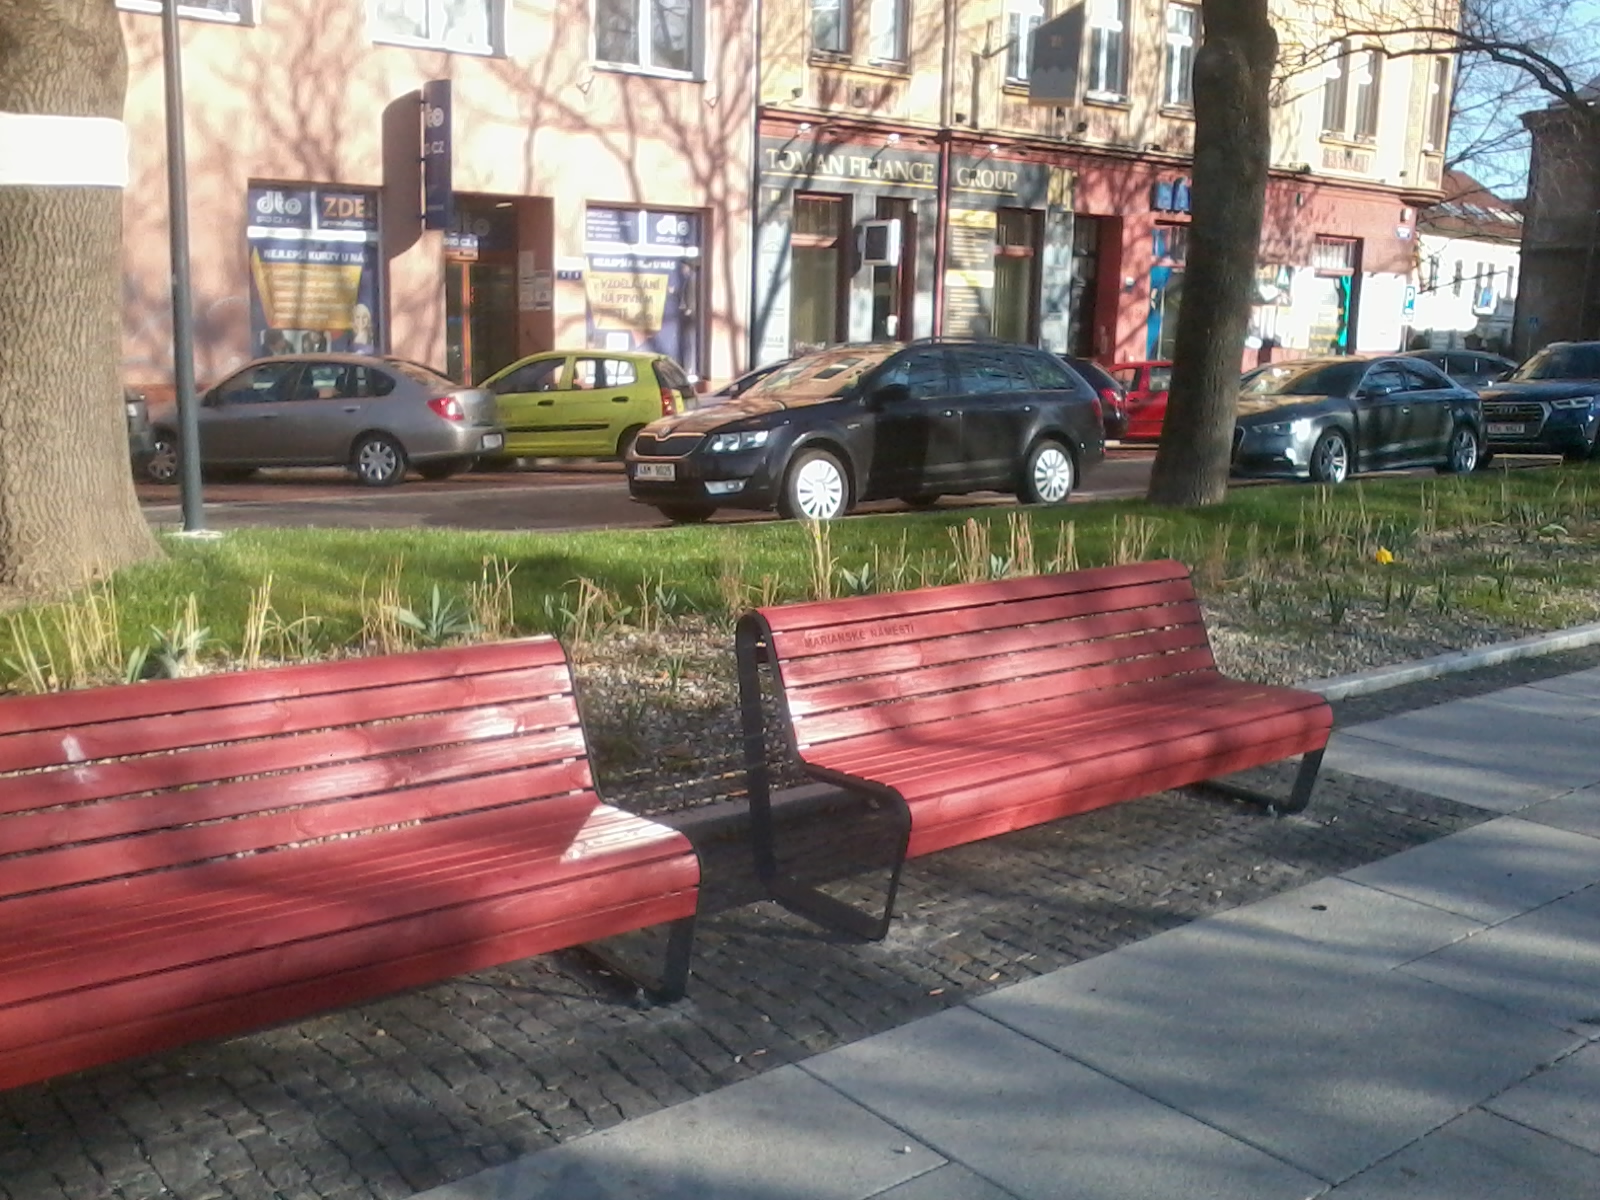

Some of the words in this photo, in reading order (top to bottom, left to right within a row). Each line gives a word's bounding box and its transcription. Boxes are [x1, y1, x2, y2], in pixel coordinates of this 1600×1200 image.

[849, 156, 935, 183] FINANCE
[957, 167, 1017, 190] GROUP
[256, 191, 302, 214] dto
